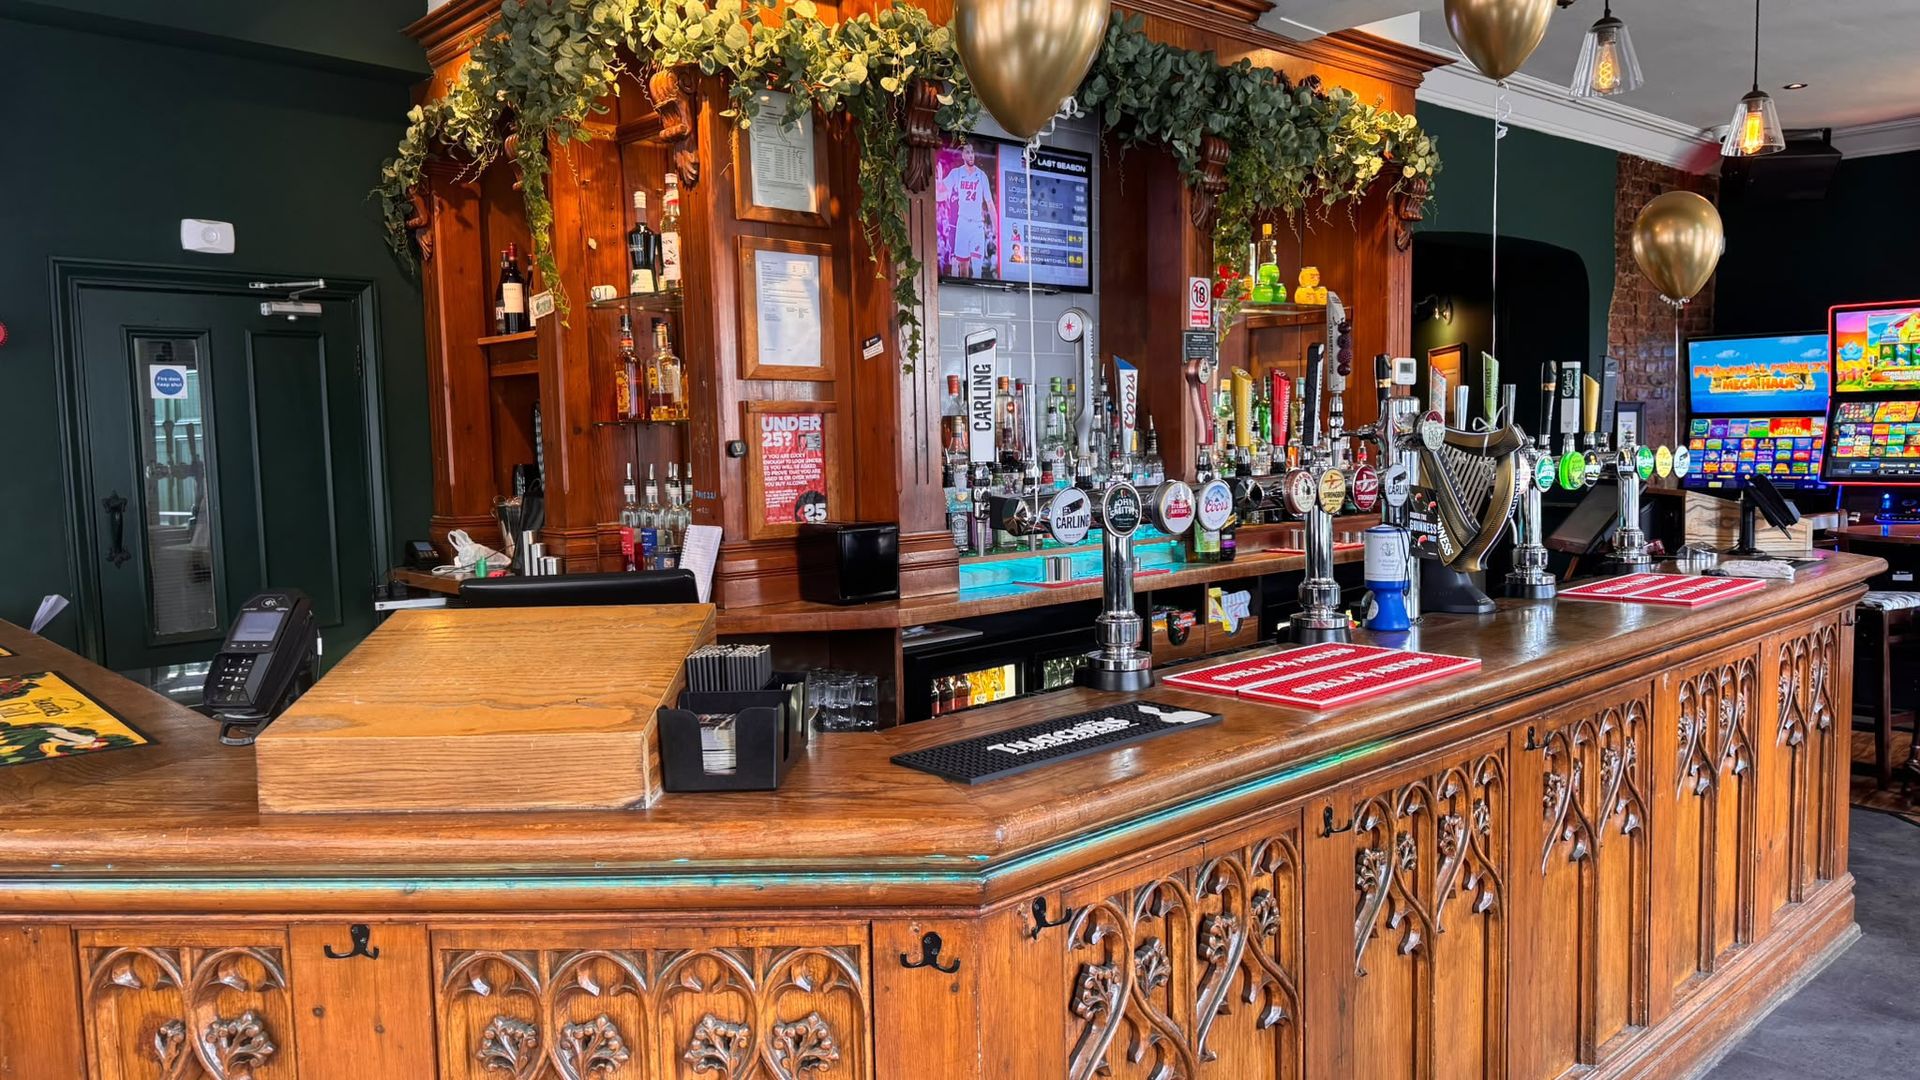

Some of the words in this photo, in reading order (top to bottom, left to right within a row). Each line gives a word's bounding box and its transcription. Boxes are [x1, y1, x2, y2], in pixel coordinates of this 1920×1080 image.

[1037, 159, 1056, 168] LAST
[1057, 162, 1087, 173] SEASON
[960, 179, 980, 190] HEAT
[965, 191, 977, 201] 24
[1193, 286, 1206, 303] 18
[973, 363, 992, 432] CARLING
[1123, 372, 1136, 430] Coors
[761, 416, 822, 432] UNDER
[762, 431, 792, 448] 25?
[1114, 499, 1135, 509] JOHN
[1205, 500, 1229, 513] Coors
[803, 503, 827, 522] 25
[1056, 515, 1090, 530] CARLING
[1409, 519, 1437, 535] GUINNESS
